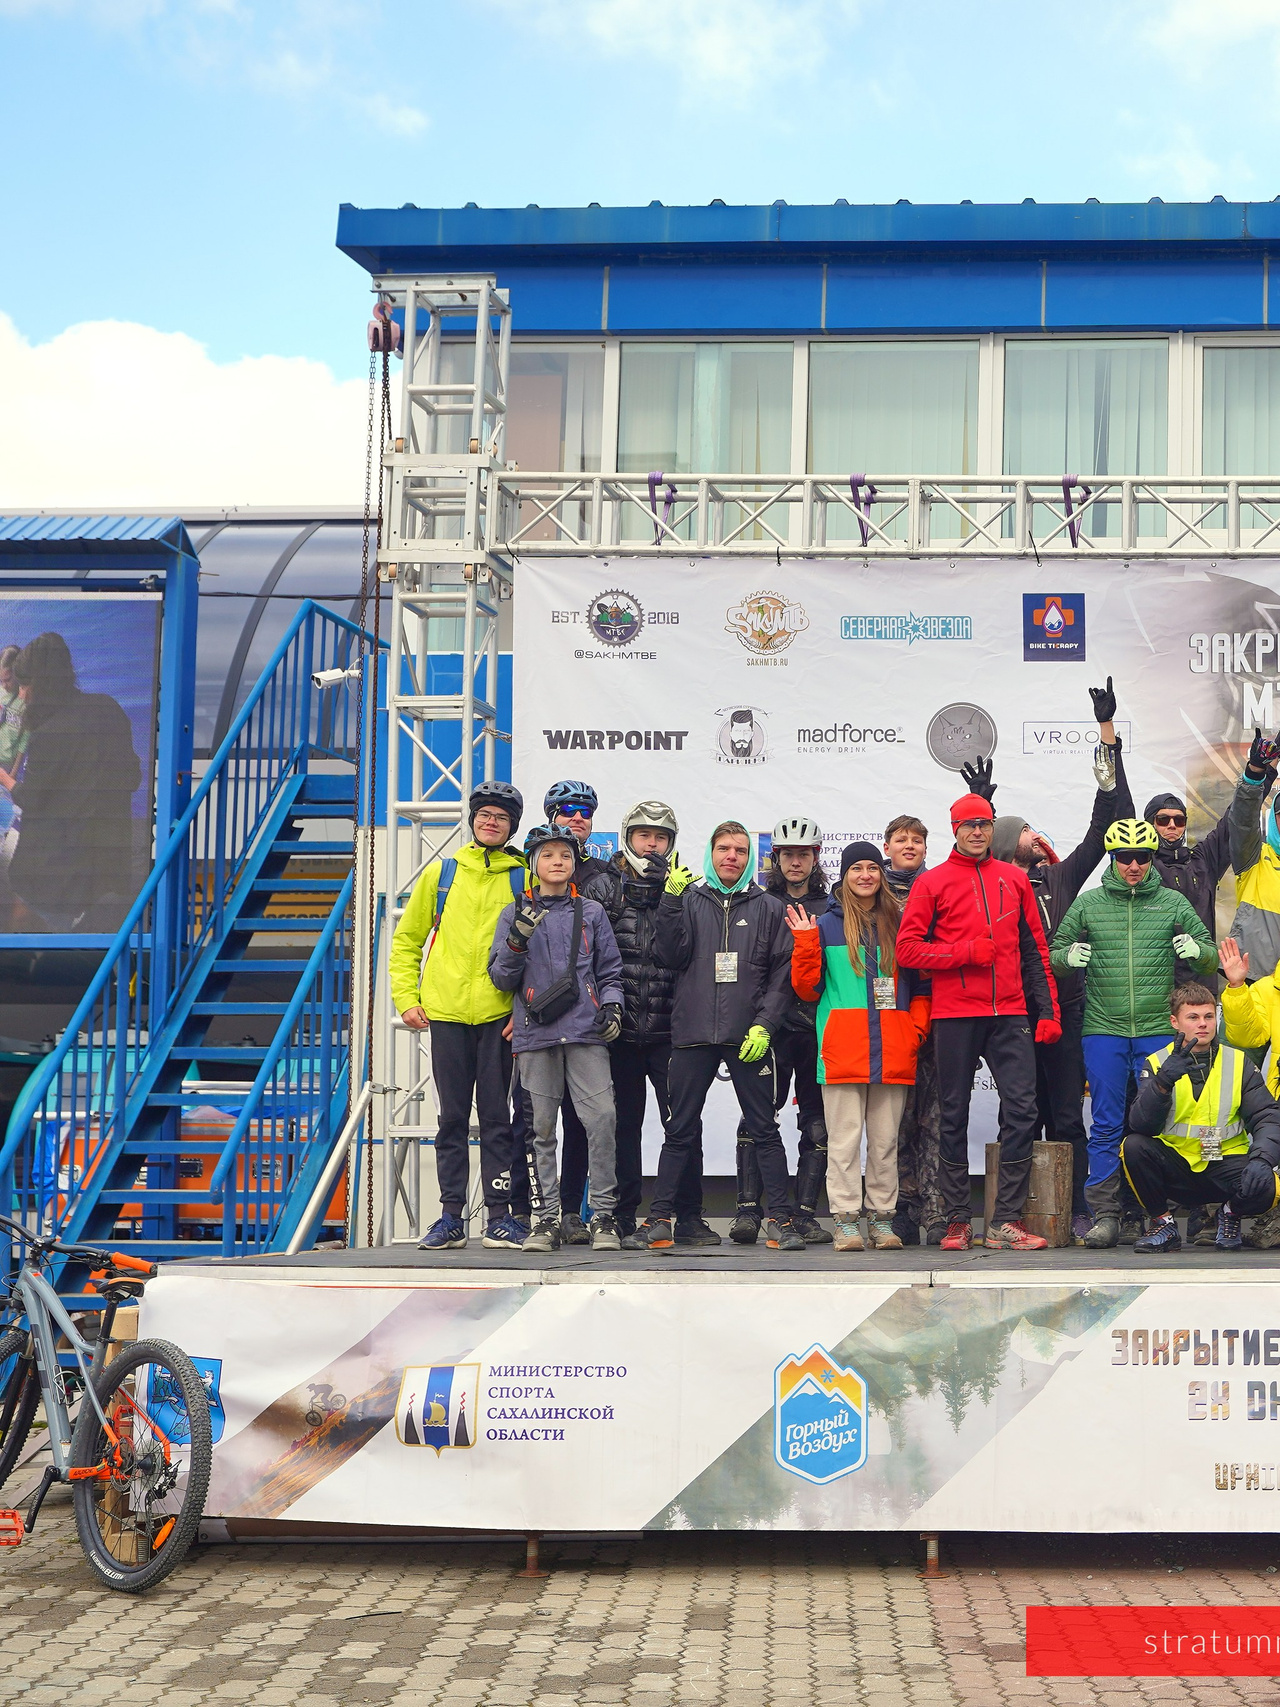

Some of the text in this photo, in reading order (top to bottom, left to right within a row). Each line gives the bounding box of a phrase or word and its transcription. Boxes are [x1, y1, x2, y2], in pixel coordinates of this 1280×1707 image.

[551, 610, 583, 624] EST.
[647, 611, 680, 625] 2018
[841, 616, 972, 639] СЕВЕРНАЯ ЗВЕЗДА
[574, 649, 657, 660] @SAKHMTBE
[746, 657, 788, 667] SAKHMTB.RU
[838, 746, 867, 754] DRINK
[1110, 1329, 1280, 1366] ЗАКРЫТИЕ
[488, 1363, 628, 1379] МИНИСТЕРСТВО
[487, 1386, 556, 1399] СПОРТА
[486, 1404, 615, 1421] САХАЛИНСКОЙ
[785, 1409, 850, 1443] Горный
[486, 1427, 566, 1442] ОБЛАСТИ
[788, 1428, 859, 1460] Воздух
